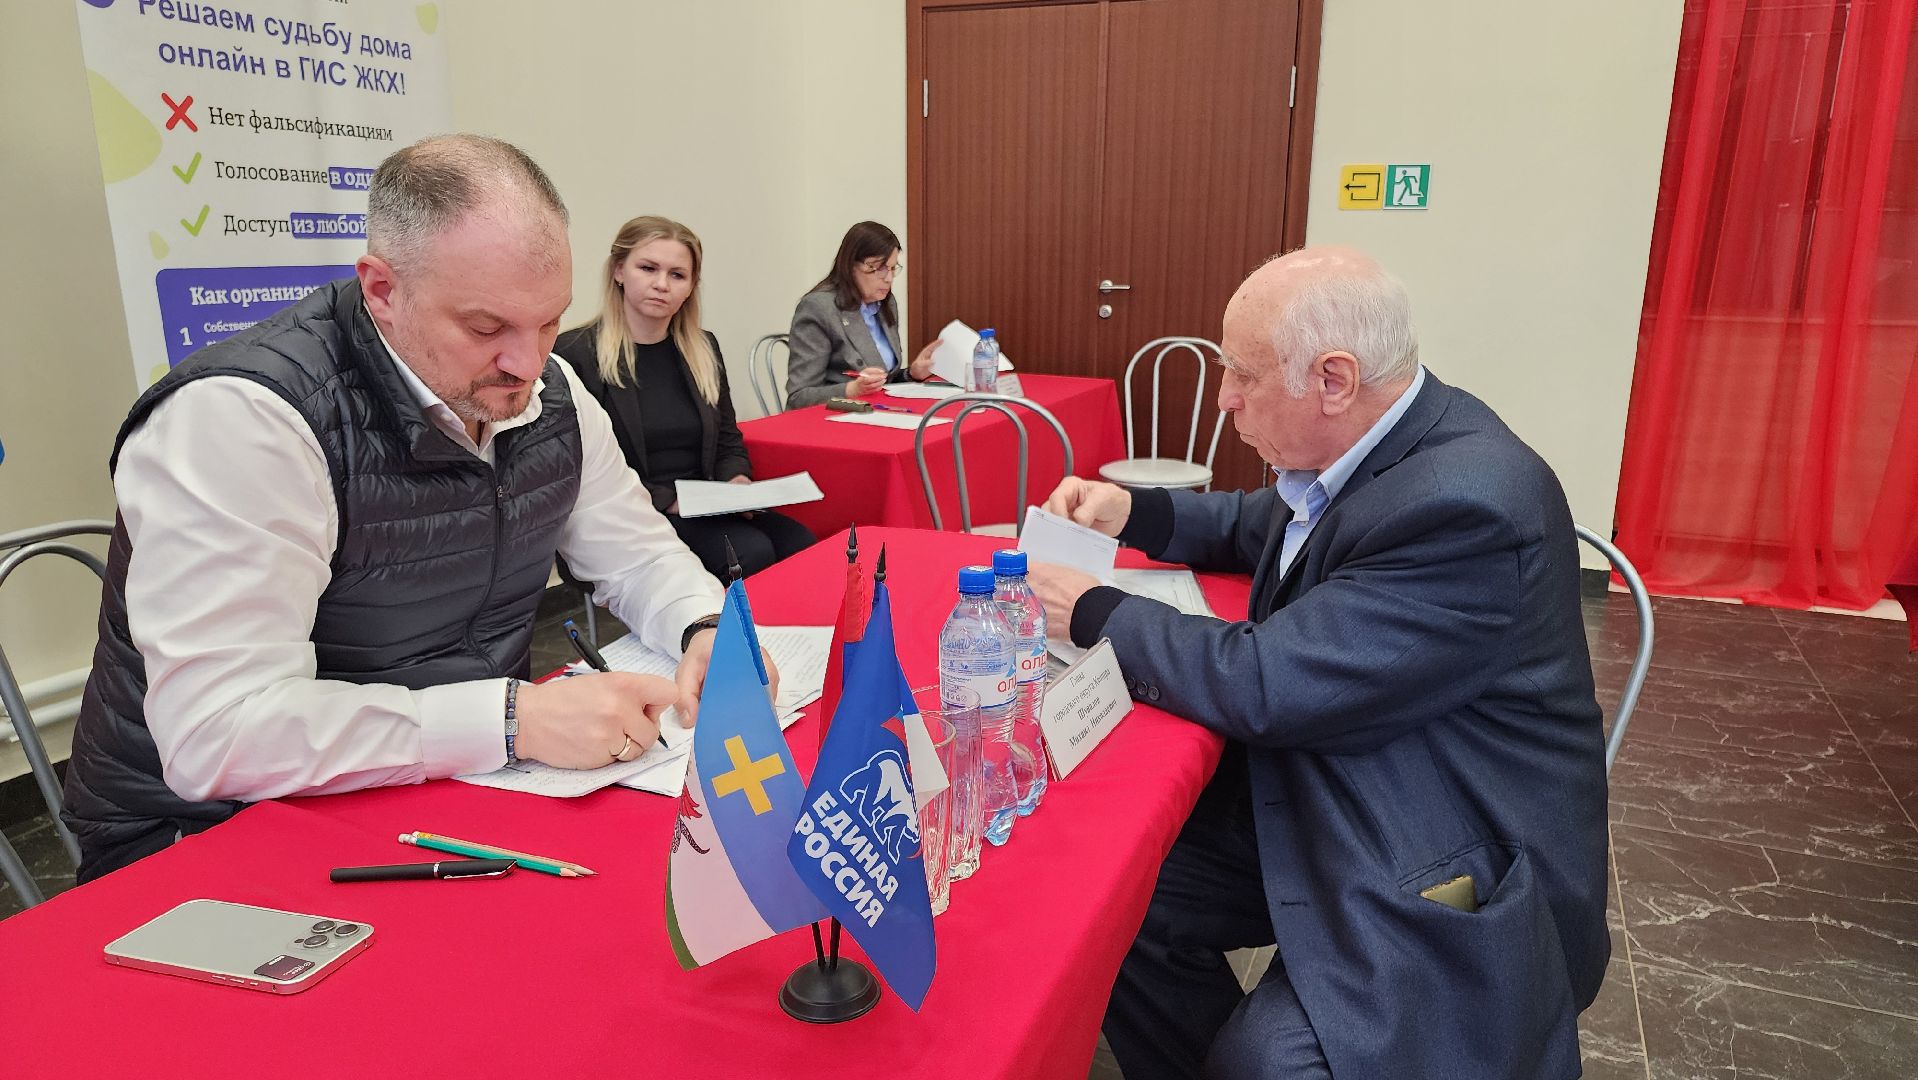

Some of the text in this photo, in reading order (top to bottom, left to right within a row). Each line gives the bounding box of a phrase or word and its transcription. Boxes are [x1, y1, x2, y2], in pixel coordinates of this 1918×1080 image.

[139, 0, 412, 60] Решаем судьбу дома
[158, 42, 405, 95] онлайн в ГИС ЖКХ!
[208, 106, 393, 141] Нет фальсификациям
[214, 161, 328, 184] Голосование
[329, 171, 341, 185] в
[223, 214, 368, 237] Доступ из любой
[189, 285, 229, 305] Как
[180, 327, 193, 346] 1
[812, 790, 898, 902] ЕДИНАЯ
[795, 810, 884, 928] РОССИЯ
